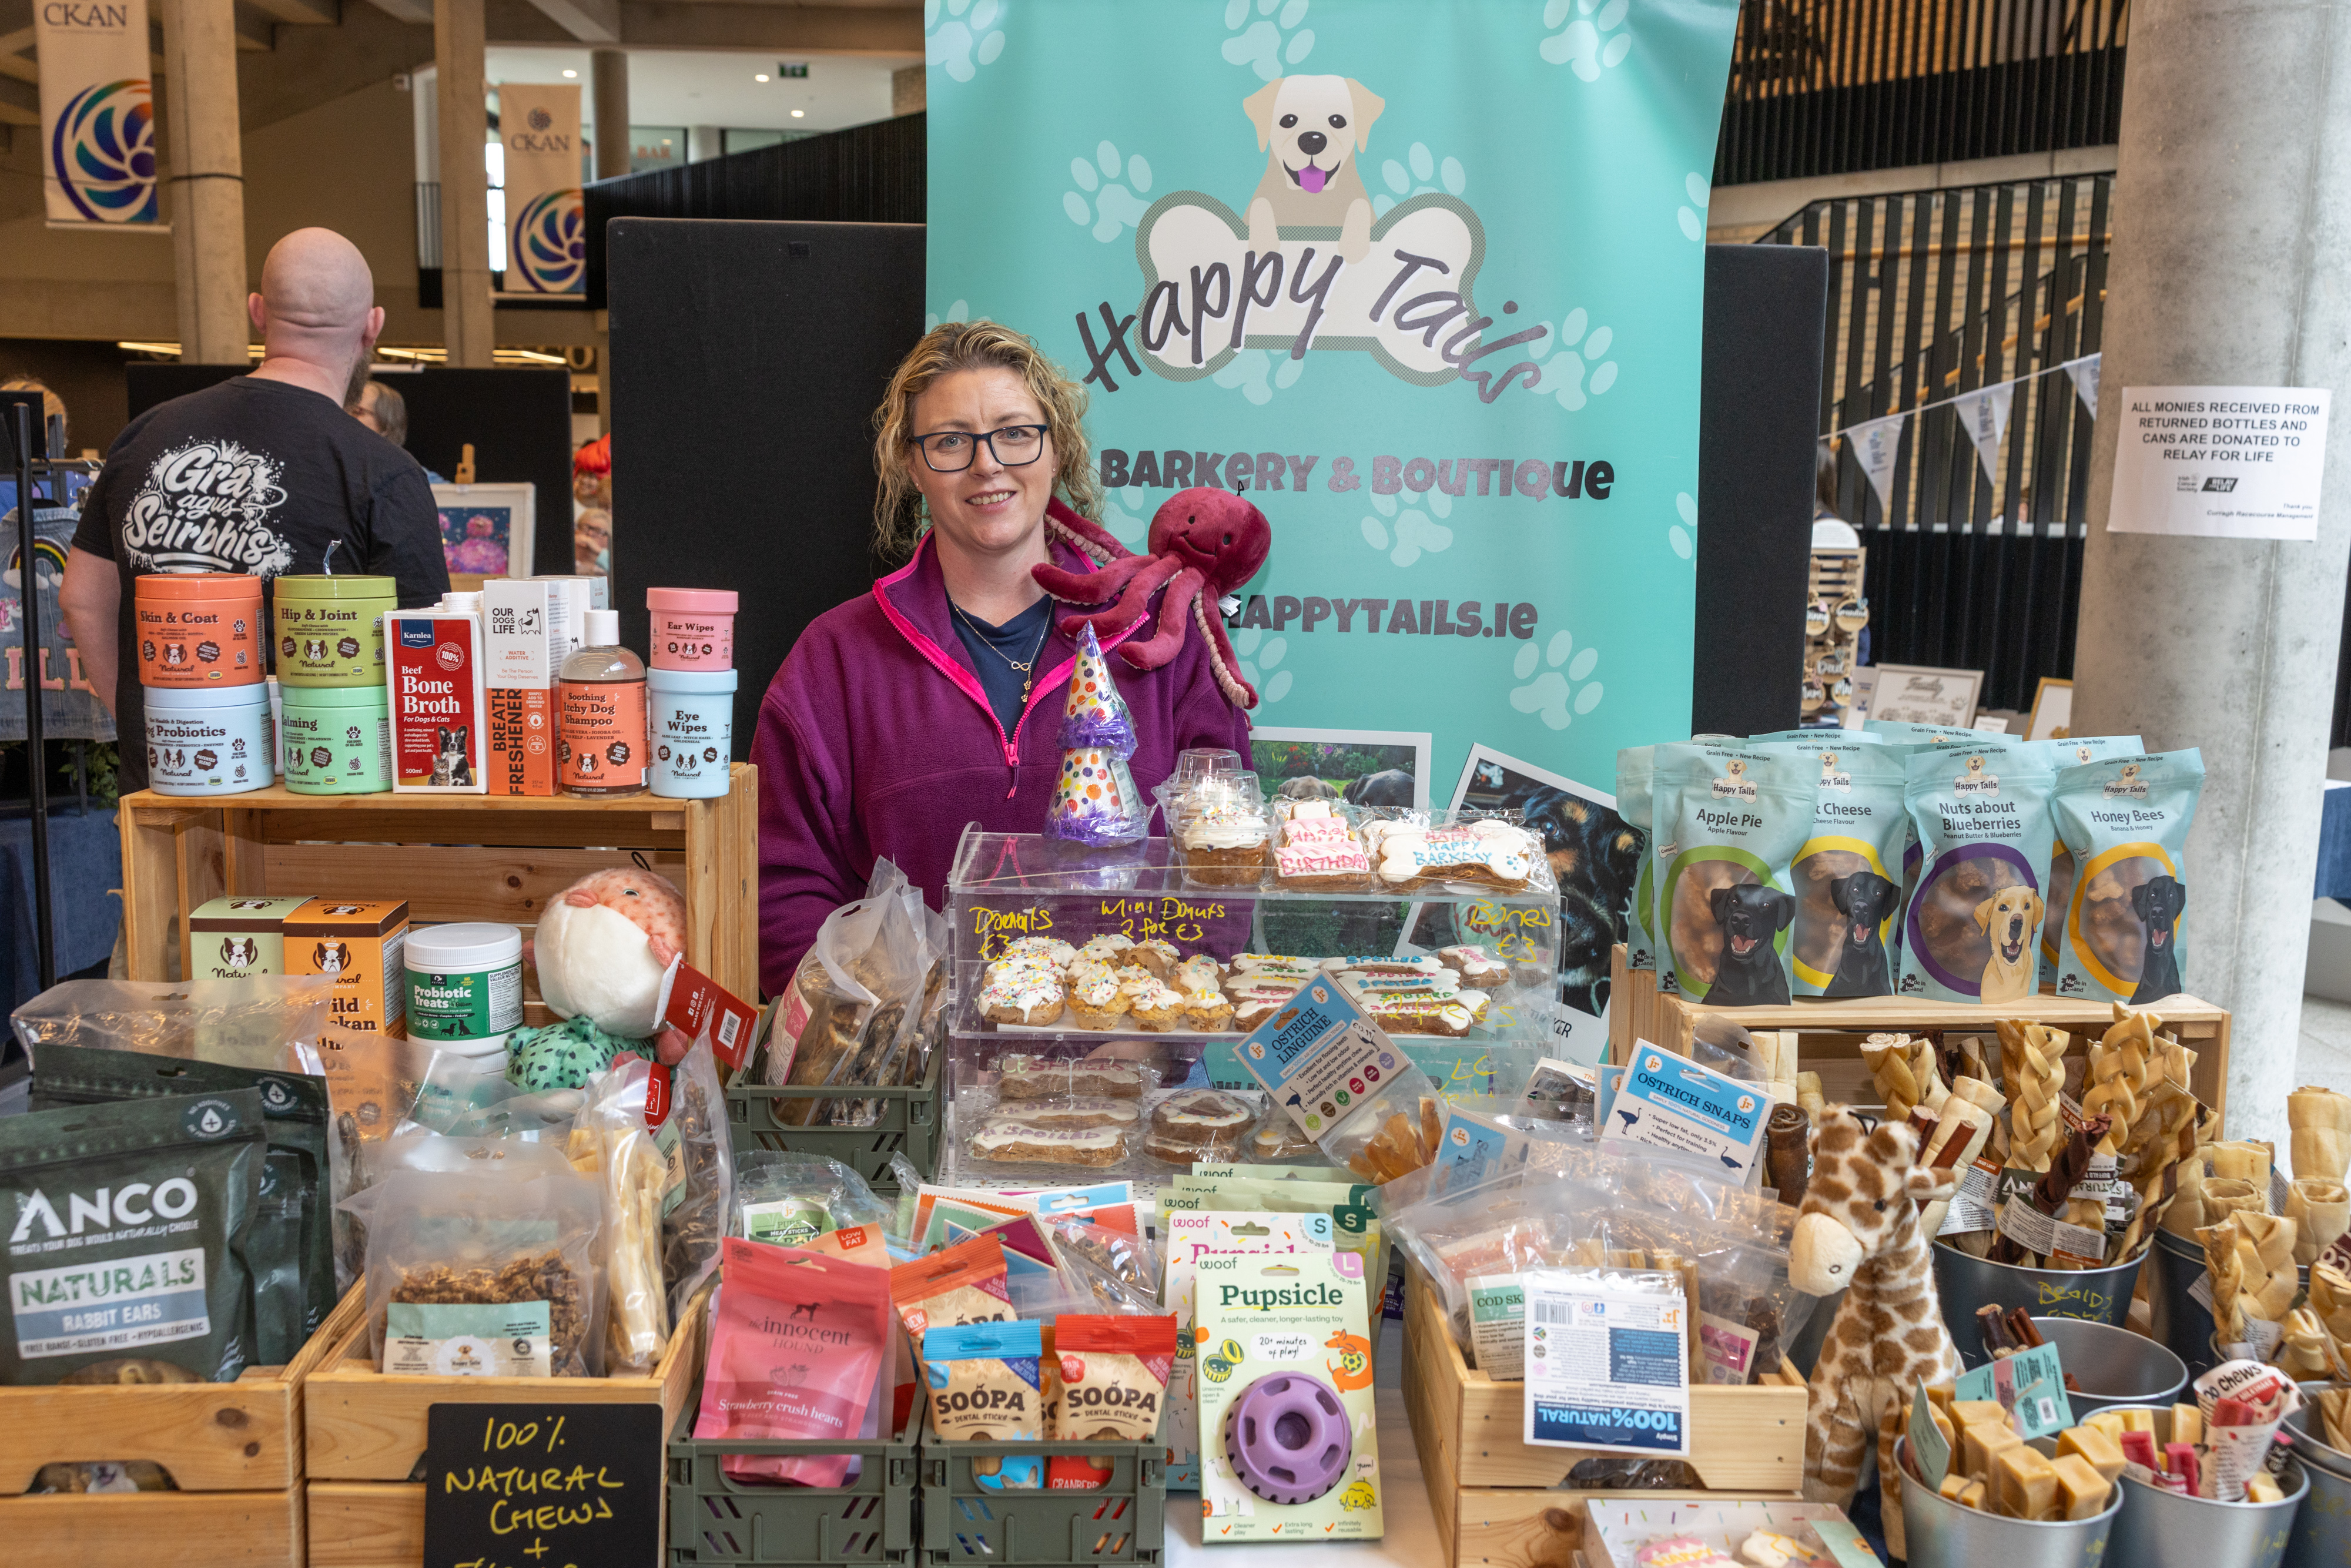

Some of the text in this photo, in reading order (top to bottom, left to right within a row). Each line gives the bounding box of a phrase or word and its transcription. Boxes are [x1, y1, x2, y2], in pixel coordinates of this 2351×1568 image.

[44, 3, 127, 27] CKAN
[510, 134, 570, 152] CKAN
[1076, 247, 1548, 404] Happy Tails
[2132, 402, 2319, 415] ALL MONIES RECEIVED FROM
[2139, 418, 2308, 431] RETURNED BOTTLES AND
[2143, 433, 2300, 447] CANS ARE DONATED TO
[2164, 449, 2274, 462] RELAY FOR LIFE
[1328, 456, 1362, 492] &
[177, 494, 245, 520] agus
[140, 611, 219, 624] Skin & Coat
[282, 608, 359, 622] Hip & Joint
[493, 608, 514, 617] OUR
[493, 625, 515, 634] LIFE
[667, 622, 714, 632] Ear Wipes
[441, 651, 459, 663] 100%
[401, 666, 423, 674] Beef
[402, 676, 453, 694] Bone
[403, 696, 461, 713] Broth
[568, 692, 607, 703] Soothing
[564, 702, 615, 715] Itchy Dog
[492, 688, 507, 752] BREATH
[565, 715, 614, 728] Shampoo
[675, 711, 699, 722] Eye
[156, 725, 226, 737] Probiotics
[667, 721, 707, 734] Wipes
[507, 689, 524, 795] FRESHENER
[671, 770, 701, 778] Natural
[1713, 783, 1755, 796] Happy Tails
[1955, 781, 1997, 791] Happy Tails
[1823, 803, 1871, 816] Cheese
[1939, 801, 2015, 815] Nuts about
[1696, 809, 1762, 827] Apple Pie
[1943, 817, 2021, 831] Blueberries
[2091, 810, 2165, 825] Honey Bees
[1707, 826, 1747, 836] Apple Flavour
[1121, 919, 1133, 939] 2
[414, 985, 471, 998] Probiotic
[414, 995, 449, 1008] Treats
[1272, 1007, 1319, 1051] OSTRICH
[1277, 1014, 1332, 1064] LINGUINE
[1638, 1073, 1751, 1129] OSTRICH SNAPS
[1652, 1114, 1717, 1147] Super low fat, only 3.5%
[9, 1177, 198, 1243] ANCO
[1173, 1215, 1210, 1229] woof
[1314, 1218, 1326, 1234] S
[841, 1231, 861, 1241] LOW
[846, 1237, 861, 1247] FAT
[1200, 1257, 1238, 1269] woof
[1342, 1254, 1355, 1271] L
[20, 1258, 195, 1306] NATURALS
[1220, 1282, 1343, 1311] Pupsicle
[1477, 1296, 1503, 1308] COD
[62, 1303, 162, 1333] RABBIT EARS
[1280, 1315, 1330, 1324] longer-lasting
[764, 1316, 850, 1346] innocent
[773, 1338, 823, 1353] HOUND
[1277, 1336, 1307, 1345] minutes
[1268, 1346, 1299, 1359] of play!
[718, 1399, 843, 1428] Strawberry crush hearts
[955, 1413, 979, 1423] DENTAL
[1114, 1410, 1138, 1420] STICKS
[1538, 1408, 1678, 1431] 100% NATURAL
[484, 1416, 565, 1453] 100%
[446, 1465, 624, 1496] NATURAL
